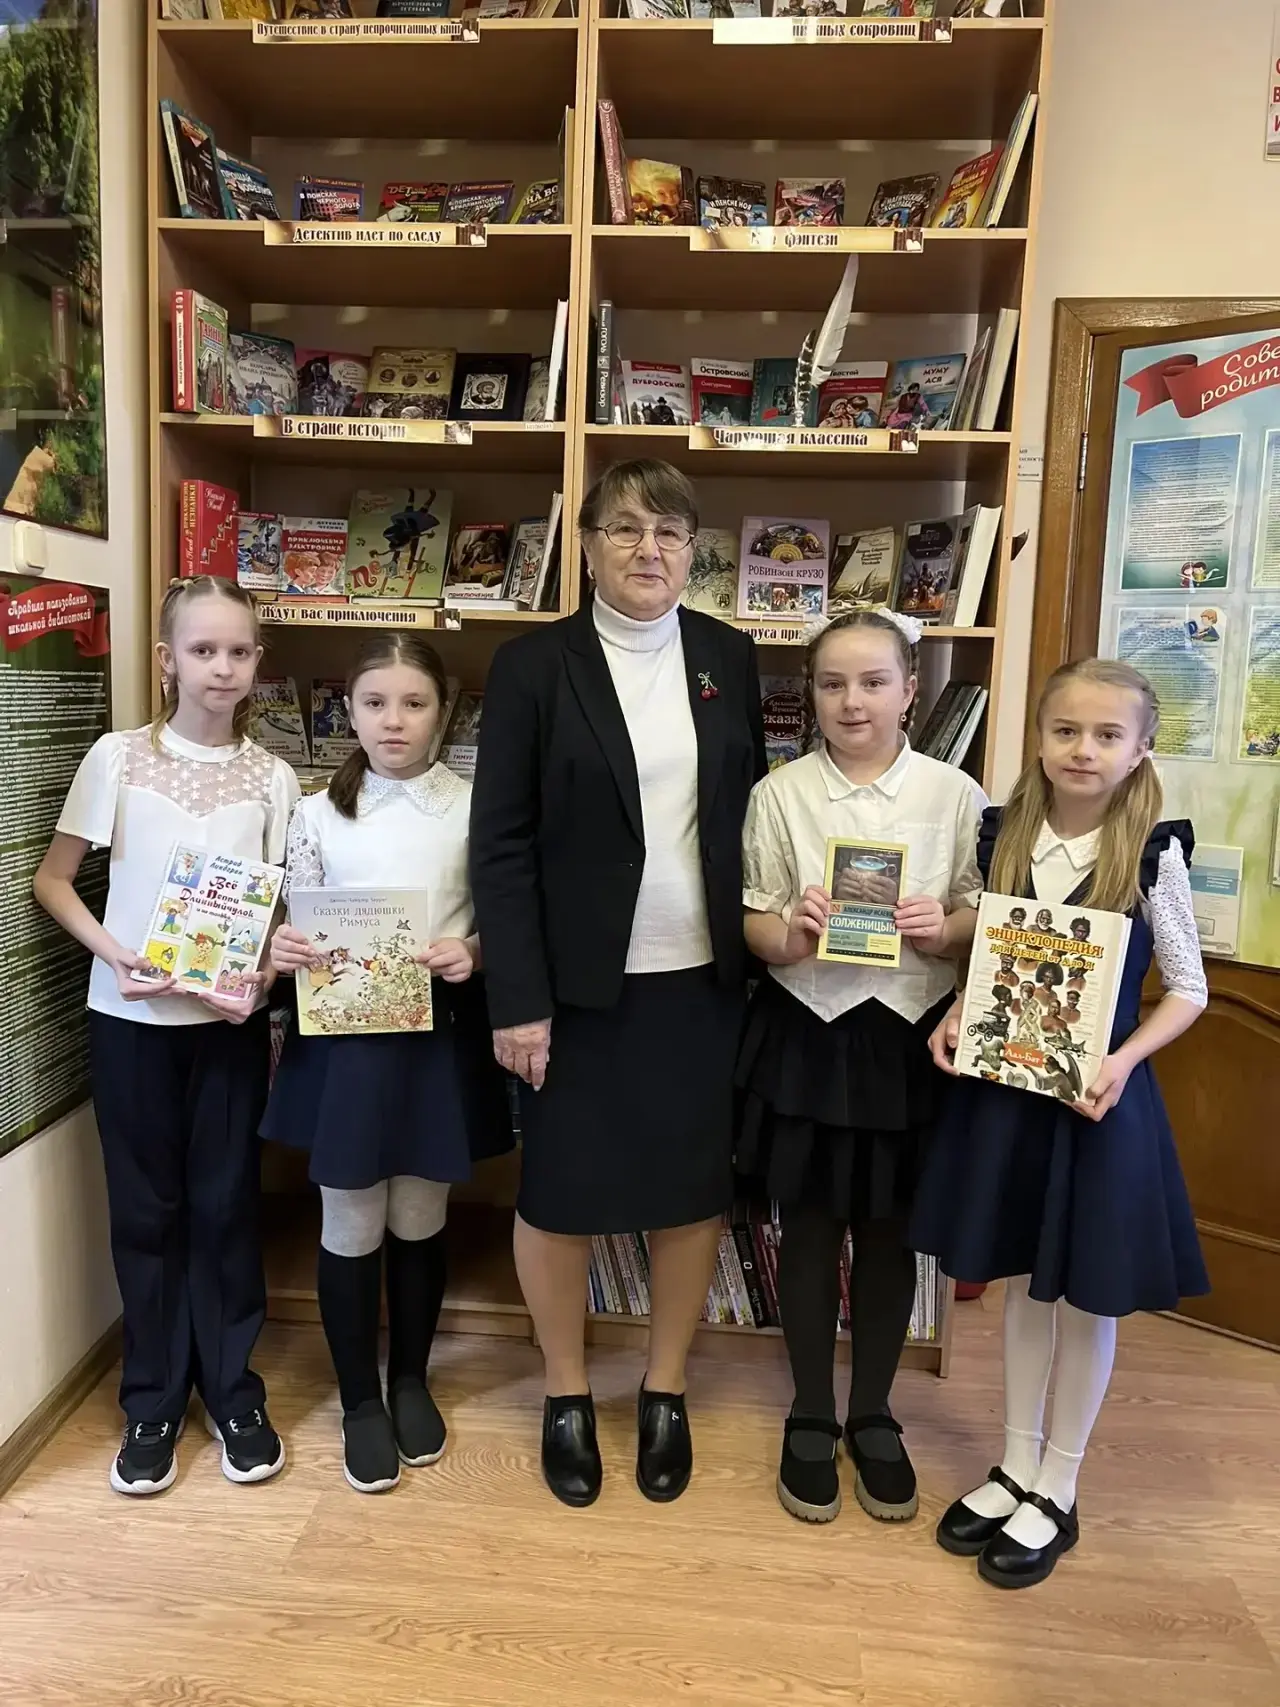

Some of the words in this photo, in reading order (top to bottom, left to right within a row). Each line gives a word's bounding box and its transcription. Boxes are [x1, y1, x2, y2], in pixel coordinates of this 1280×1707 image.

[257, 23, 319, 36] Путешествие
[320, 25, 327, 36] в
[329, 24, 361, 37] страну
[363, 24, 438, 37] непрочитанных
[440, 23, 463, 36] книг
[849, 22, 916, 39] сокровищ
[306, 191, 338, 199] ПОИСКАХ
[525, 191, 543, 205] НА
[709, 200, 716, 208] И
[715, 199, 738, 208] ПЕНСНЕ
[738, 201, 753, 211] НОЯ
[294, 228, 352, 243] Детектив
[356, 230, 385, 242] идет
[388, 231, 404, 242] по
[407, 230, 442, 244] следу
[784, 233, 839, 247] фэнтези
[600, 327, 608, 354] ГОГОЛЬ
[700, 365, 750, 378] Островский
[922, 366, 950, 376] МУМУ
[632, 377, 686, 389] ДУБРОВСКИЙ
[924, 376, 943, 384] АСЯ
[598, 371, 609, 408] Ревизор
[283, 418, 294, 436] В
[297, 420, 344, 437] стране
[348, 422, 406, 440] истории
[714, 429, 795, 446] Чарующая
[800, 432, 868, 446] классика
[189, 484, 197, 528] НЕЗНАЙКИ
[287, 536, 345, 545] ПРИКЛЮЧЕНИЯ
[288, 543, 342, 552] ЭЛЕКТРОНИКА
[795, 567, 825, 579] КРУЗО
[7, 598, 45, 619] Правила
[46, 592, 88, 612] пользования
[261, 605, 298, 620] Ждут
[300, 608, 324, 620] вас
[327, 609, 417, 623] приключения
[8, 616, 46, 635] школьной
[47, 608, 92, 627] библиотекой
[739, 627, 778, 641] аруса
[215, 855, 243, 868] Астрид
[210, 862, 244, 876] Линдгрен
[209, 875, 239, 890] Всё
[179, 887, 255, 918] Длинныйчулок
[206, 888, 240, 905] Пеппи
[313, 905, 350, 916] Сказки
[354, 906, 406, 917] дядюшки
[843, 906, 874, 916] АЛЕКСАНДР
[340, 916, 381, 929] Римуса
[830, 916, 896, 934] СОЛЖЕНИЦЫН
[986, 926, 1103, 957] ЭНЦИКЛОПЕДИЯ
[990, 943, 1012, 954] ДЛЯ
[1013, 947, 1048, 961] ДЕТЕЙ
[1048, 955, 1060, 963] от
[1071, 960, 1084, 968] до
